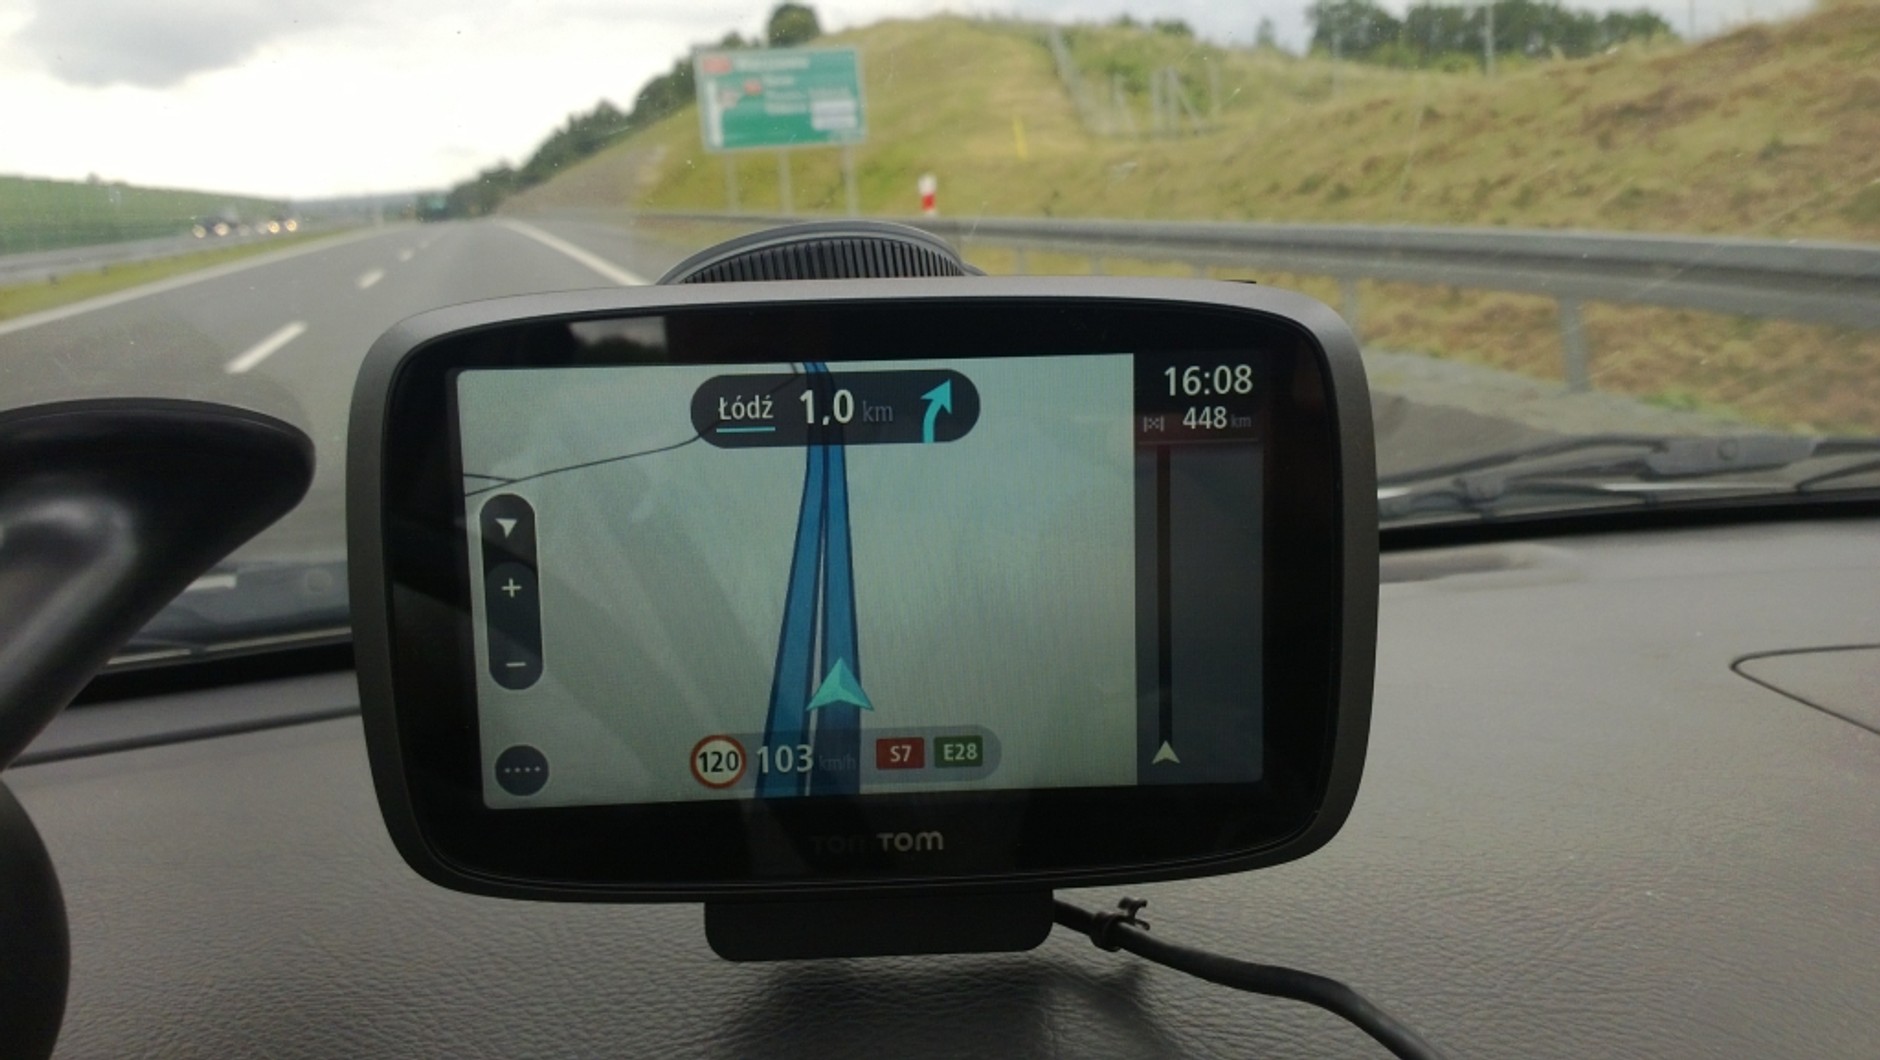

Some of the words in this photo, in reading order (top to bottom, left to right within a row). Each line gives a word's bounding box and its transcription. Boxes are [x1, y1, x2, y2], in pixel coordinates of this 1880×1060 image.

[1164, 364, 1253, 396] 16:08
[718, 394, 774, 420] Łódź
[862, 401, 893, 422] km
[1182, 406, 1228, 429] 448
[1231, 414, 1252, 428] km
[698, 750, 740, 773] 120
[756, 745, 814, 773] 103
[890, 745, 912, 763] S7
[943, 743, 979, 761] E28
